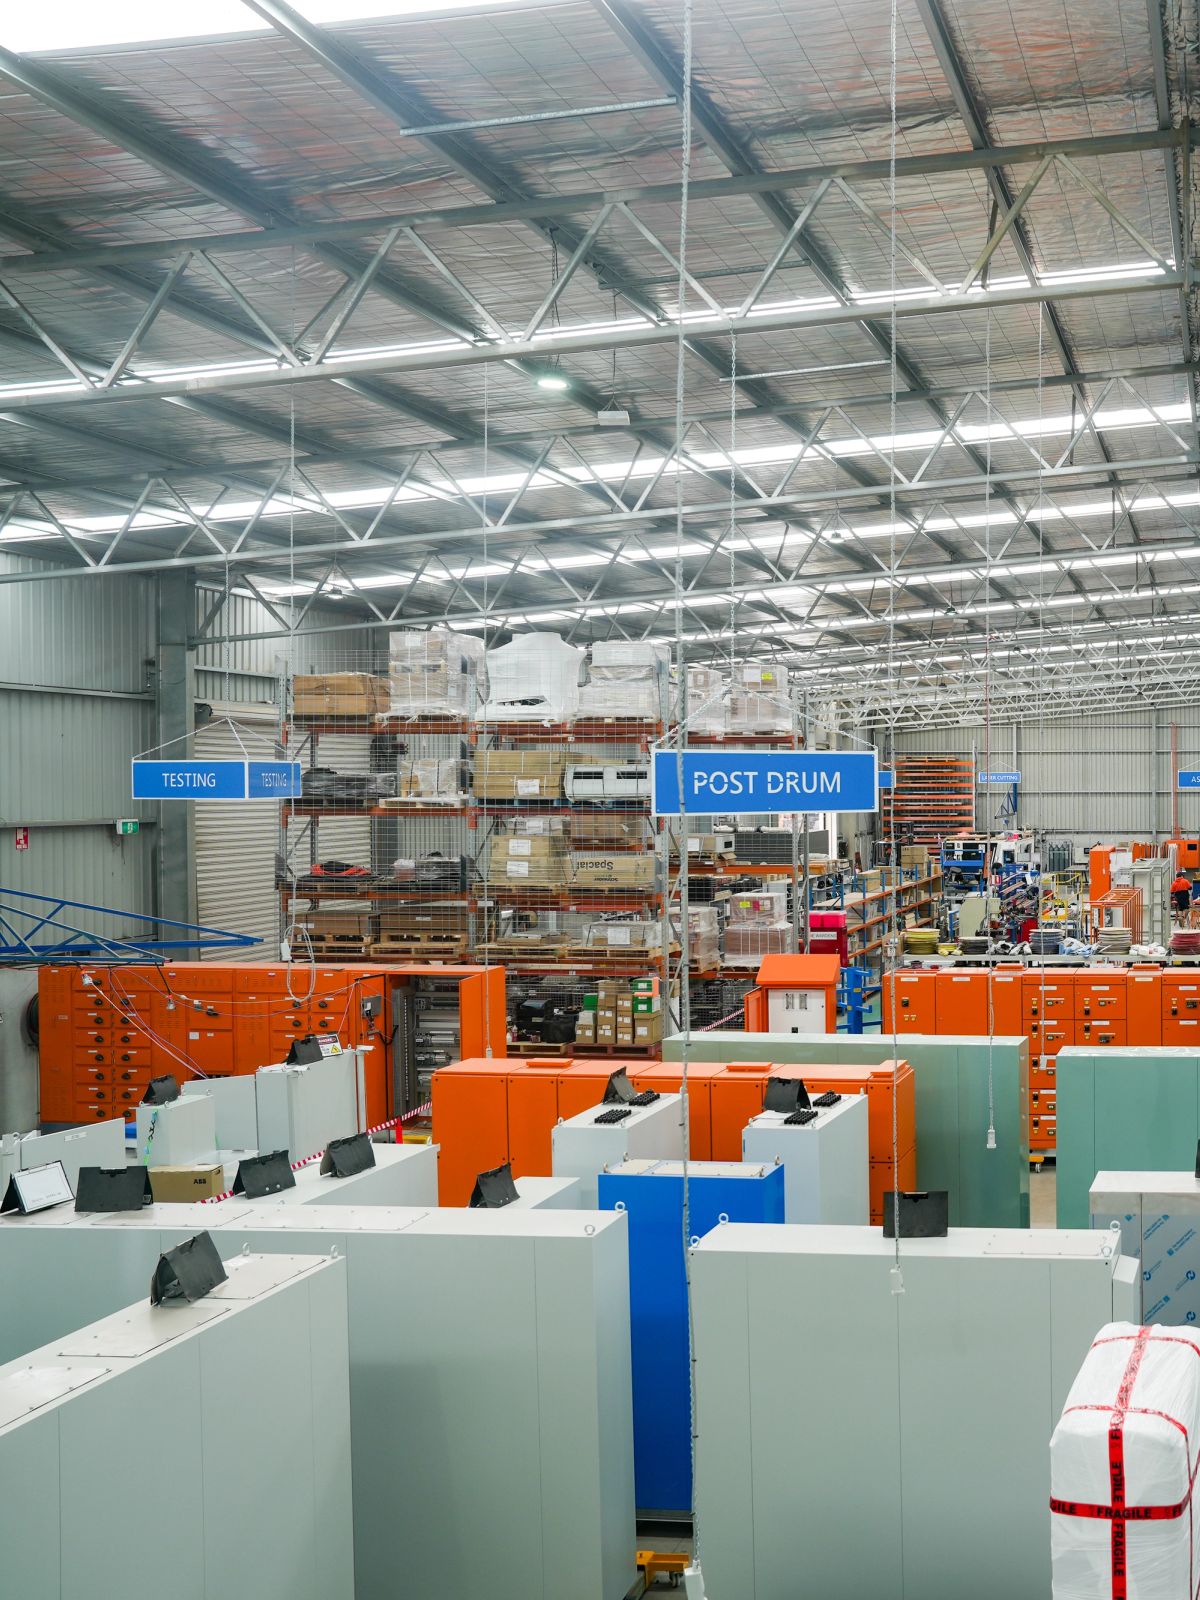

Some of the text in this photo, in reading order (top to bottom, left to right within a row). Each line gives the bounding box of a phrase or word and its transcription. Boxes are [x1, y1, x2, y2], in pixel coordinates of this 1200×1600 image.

[161, 773, 216, 787] TESTING
[261, 773, 287, 787] TESTING
[693, 771, 841, 795] POST DRUM
[1050, 1500, 1076, 1515] GILE
[1097, 1506, 1152, 1518] FRAGILE
[1114, 1523, 1125, 1576] FRAGILE
